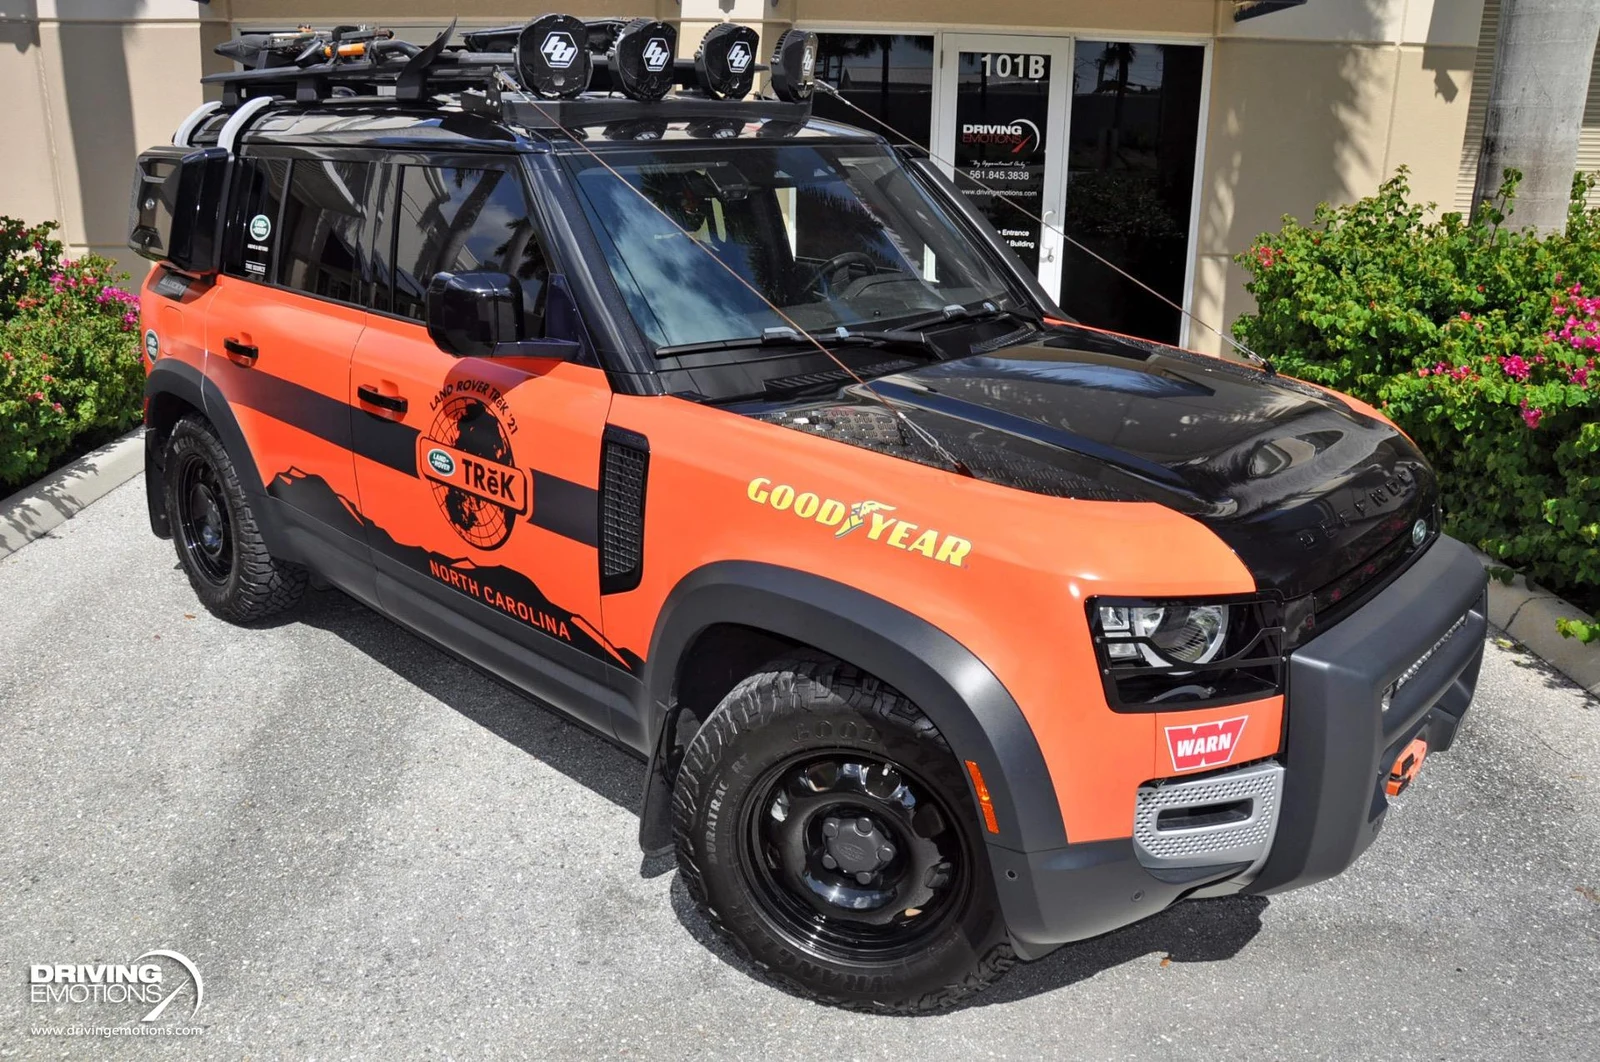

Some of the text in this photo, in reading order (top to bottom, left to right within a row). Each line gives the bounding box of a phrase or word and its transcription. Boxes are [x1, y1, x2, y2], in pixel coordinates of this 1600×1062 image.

[981, 53, 1045, 79] 101B
[962, 124, 1022, 135] DRIVING
[962, 134, 1022, 144] EMOTIONS
[969, 170, 1029, 180] 561.845.3838
[1002, 229, 1030, 237] Entrance
[1010, 240, 1034, 249] Building
[430, 384, 454, 411] LAND
[456, 380, 490, 395] ROVER
[747, 477, 972, 567] GOODYEAR
[429, 559, 571, 640] NORTH CAROLINA
[1177, 732, 1232, 757] WARN
[705, 779, 730, 865] DURATRAC
